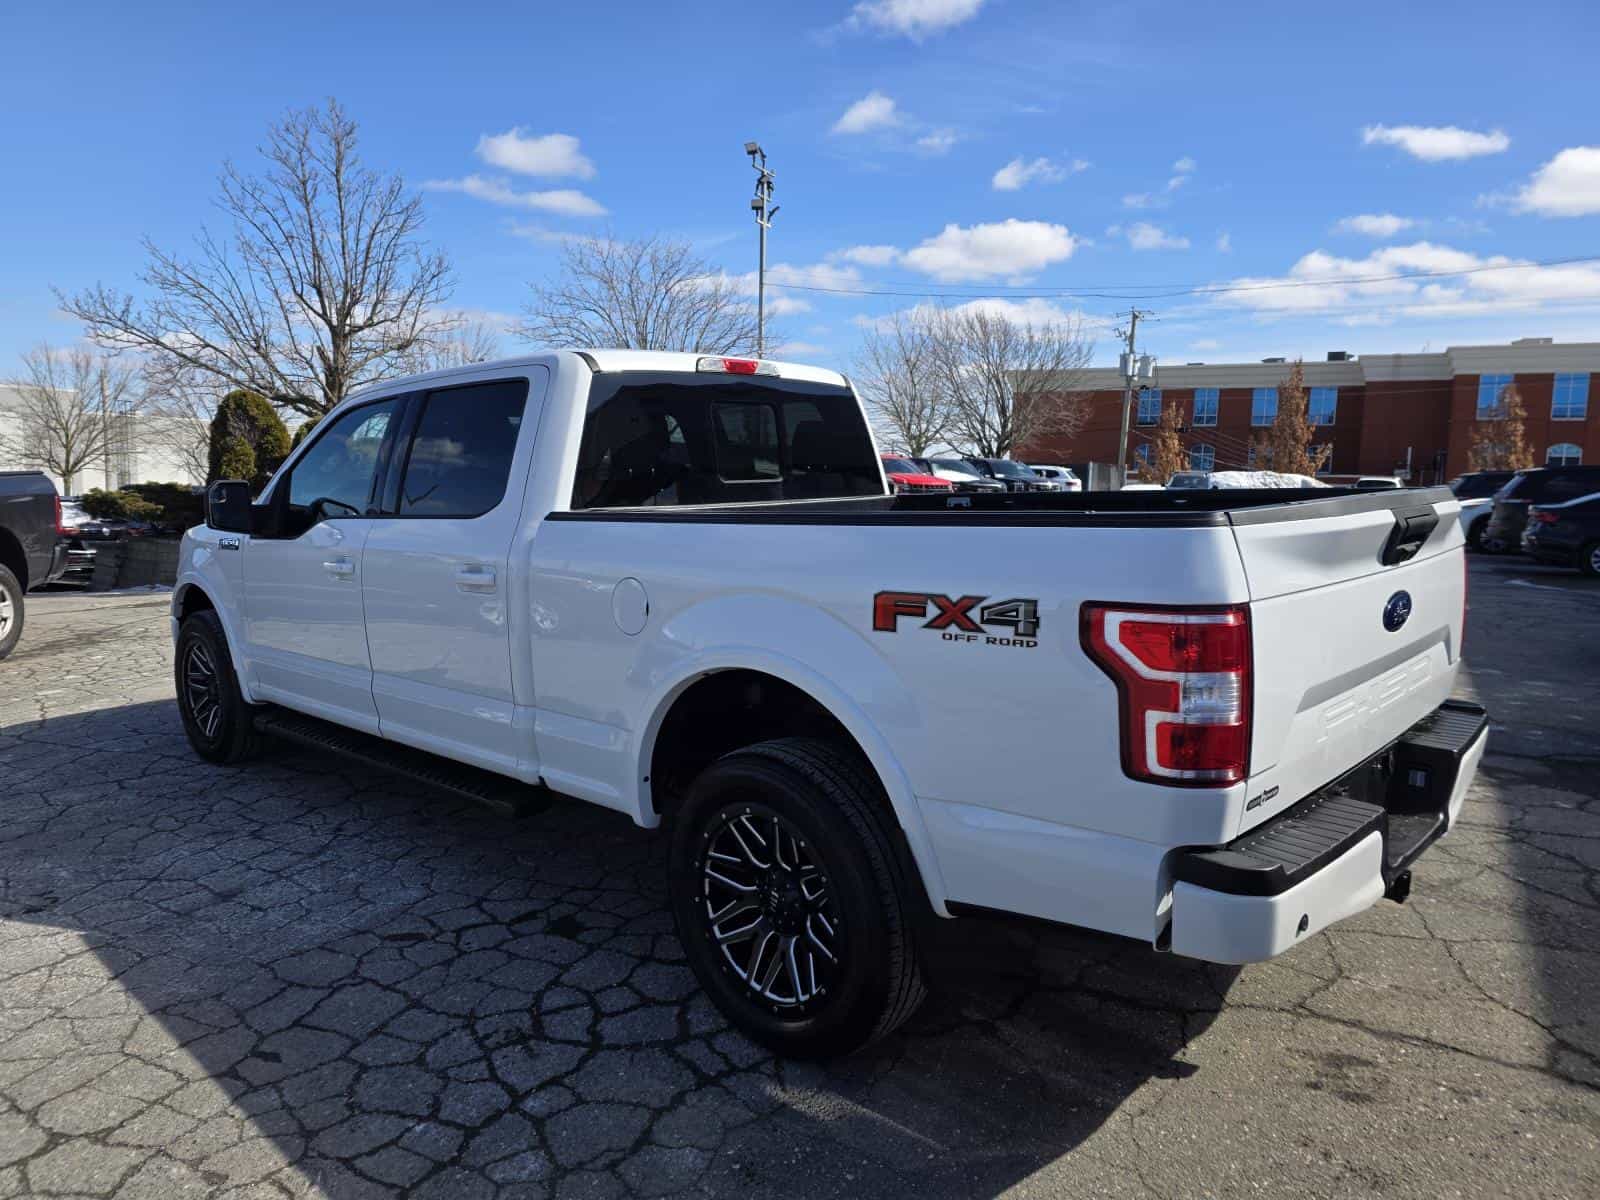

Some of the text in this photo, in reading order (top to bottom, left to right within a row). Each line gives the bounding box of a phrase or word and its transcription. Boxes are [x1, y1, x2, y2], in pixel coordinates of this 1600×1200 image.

[873, 591, 1040, 637] FX4
[942, 632, 1038, 648] OFF ROAD
